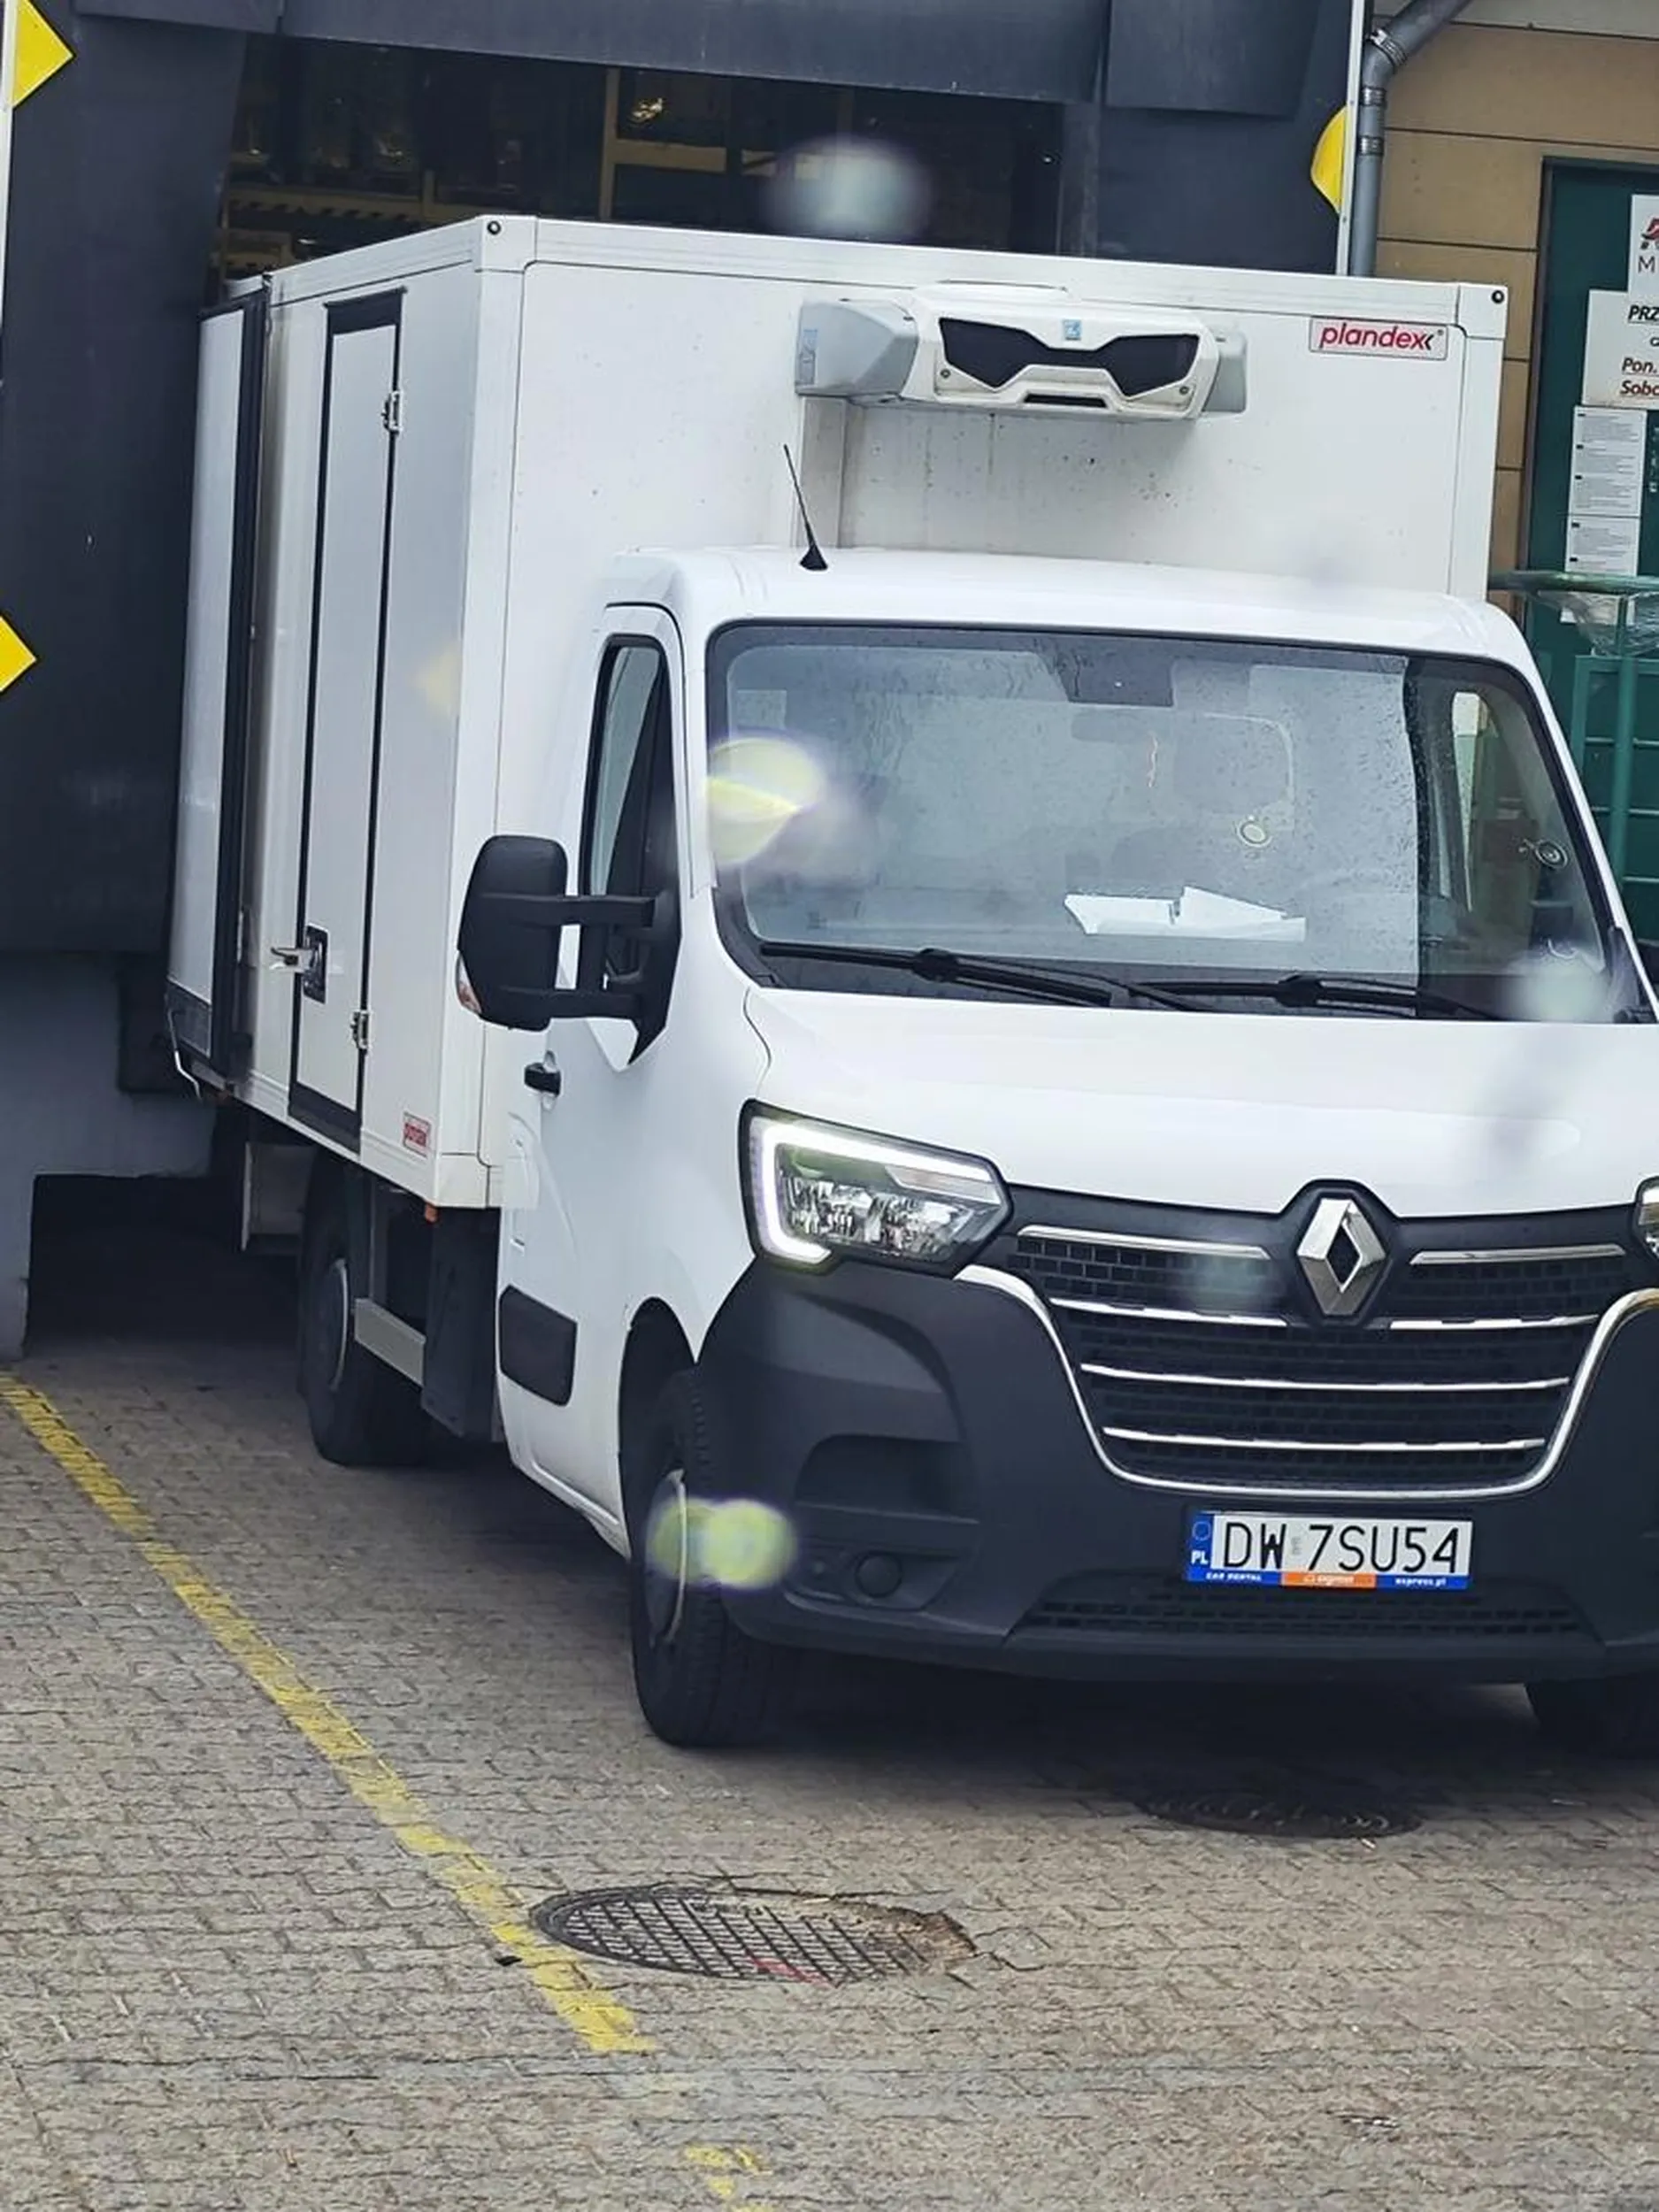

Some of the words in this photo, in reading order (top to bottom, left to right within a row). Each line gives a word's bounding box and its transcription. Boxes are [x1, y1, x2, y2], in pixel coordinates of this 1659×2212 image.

[1318, 321, 1434, 351] plandex
[1622, 357, 1657, 373] Pon.
[1190, 1549, 1210, 1565] PL
[1223, 1522, 1286, 1570] DW
[1309, 1524, 1460, 1574] 7SU54
